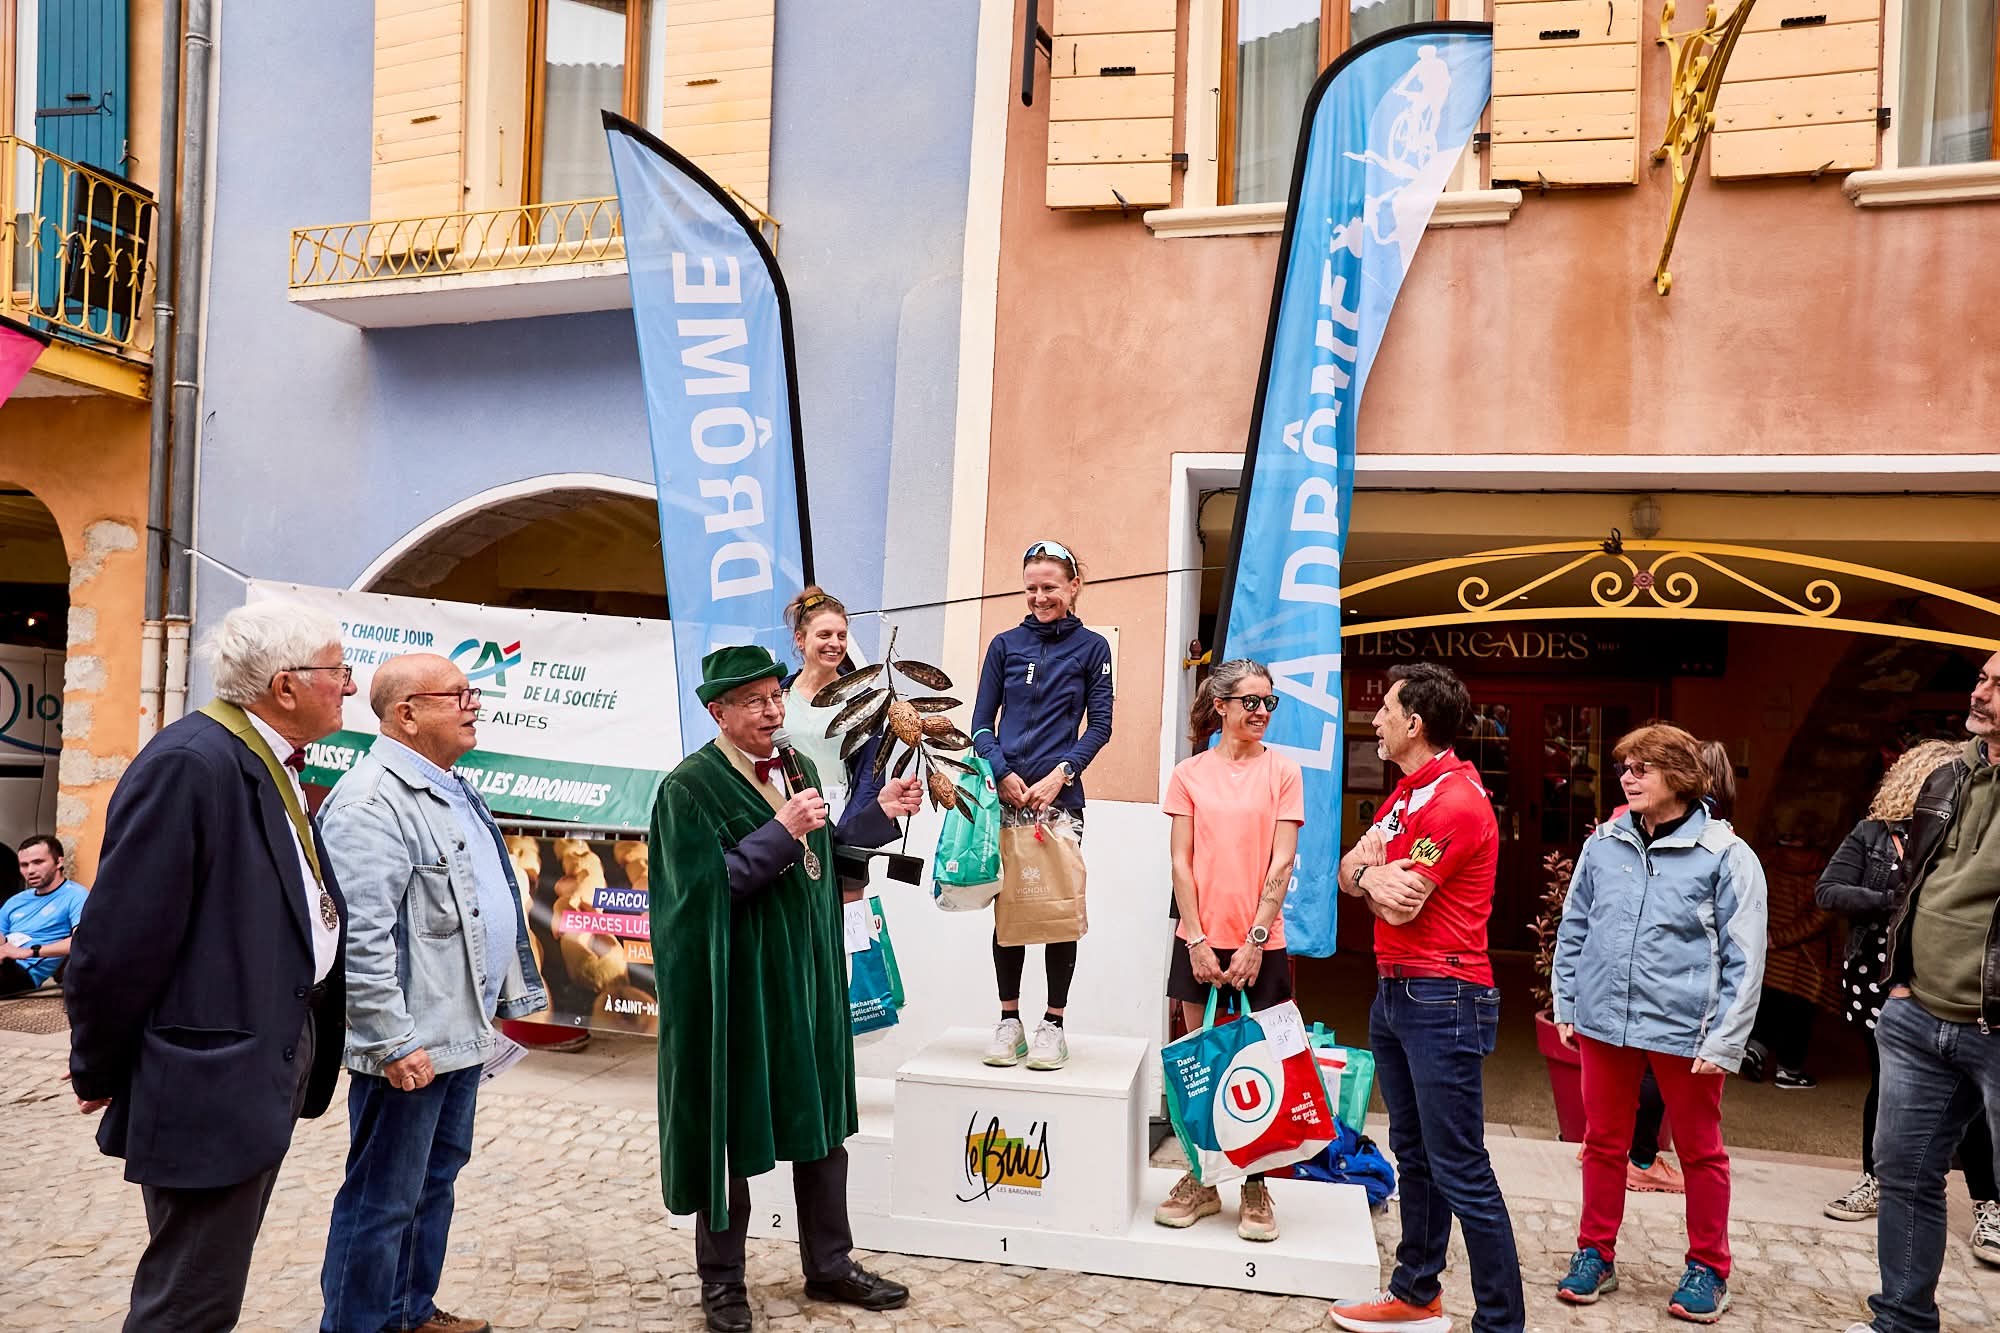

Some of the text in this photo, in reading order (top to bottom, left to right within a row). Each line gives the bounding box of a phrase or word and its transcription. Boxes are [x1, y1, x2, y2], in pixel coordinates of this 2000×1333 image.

[351, 623, 400, 643] CHAQUE
[401, 629, 434, 647] JOUR
[1358, 631, 1416, 657] LES
[1421, 631, 1589, 660] ARCADES
[343, 647, 377, 664] OTRE
[530, 661, 587, 682] ET CELUI
[523, 685, 619, 710] DE LA SOCIÉTÉ
[492, 711, 549, 729] ALPES
[1263, 653, 1341, 771] LA
[304, 742, 355, 771] CAISSE
[480, 770, 515, 795] LES
[510, 774, 612, 807] BARONNIES
[565, 914, 622, 933] ESPACES
[604, 994, 613, 1012] À
[1176, 1055, 1196, 1067] Dans
[1180, 1061, 1201, 1075] ce sac
[1199, 1066, 1211, 1076] des
[1184, 1075, 1210, 1090] valeurs
[1231, 1080, 1262, 1111] U
[1008, 1187, 1041, 1197] BARONNIES
[772, 1213, 782, 1228] 2
[1000, 1237, 1007, 1252] 1
[1245, 1261, 1256, 1278] 3
